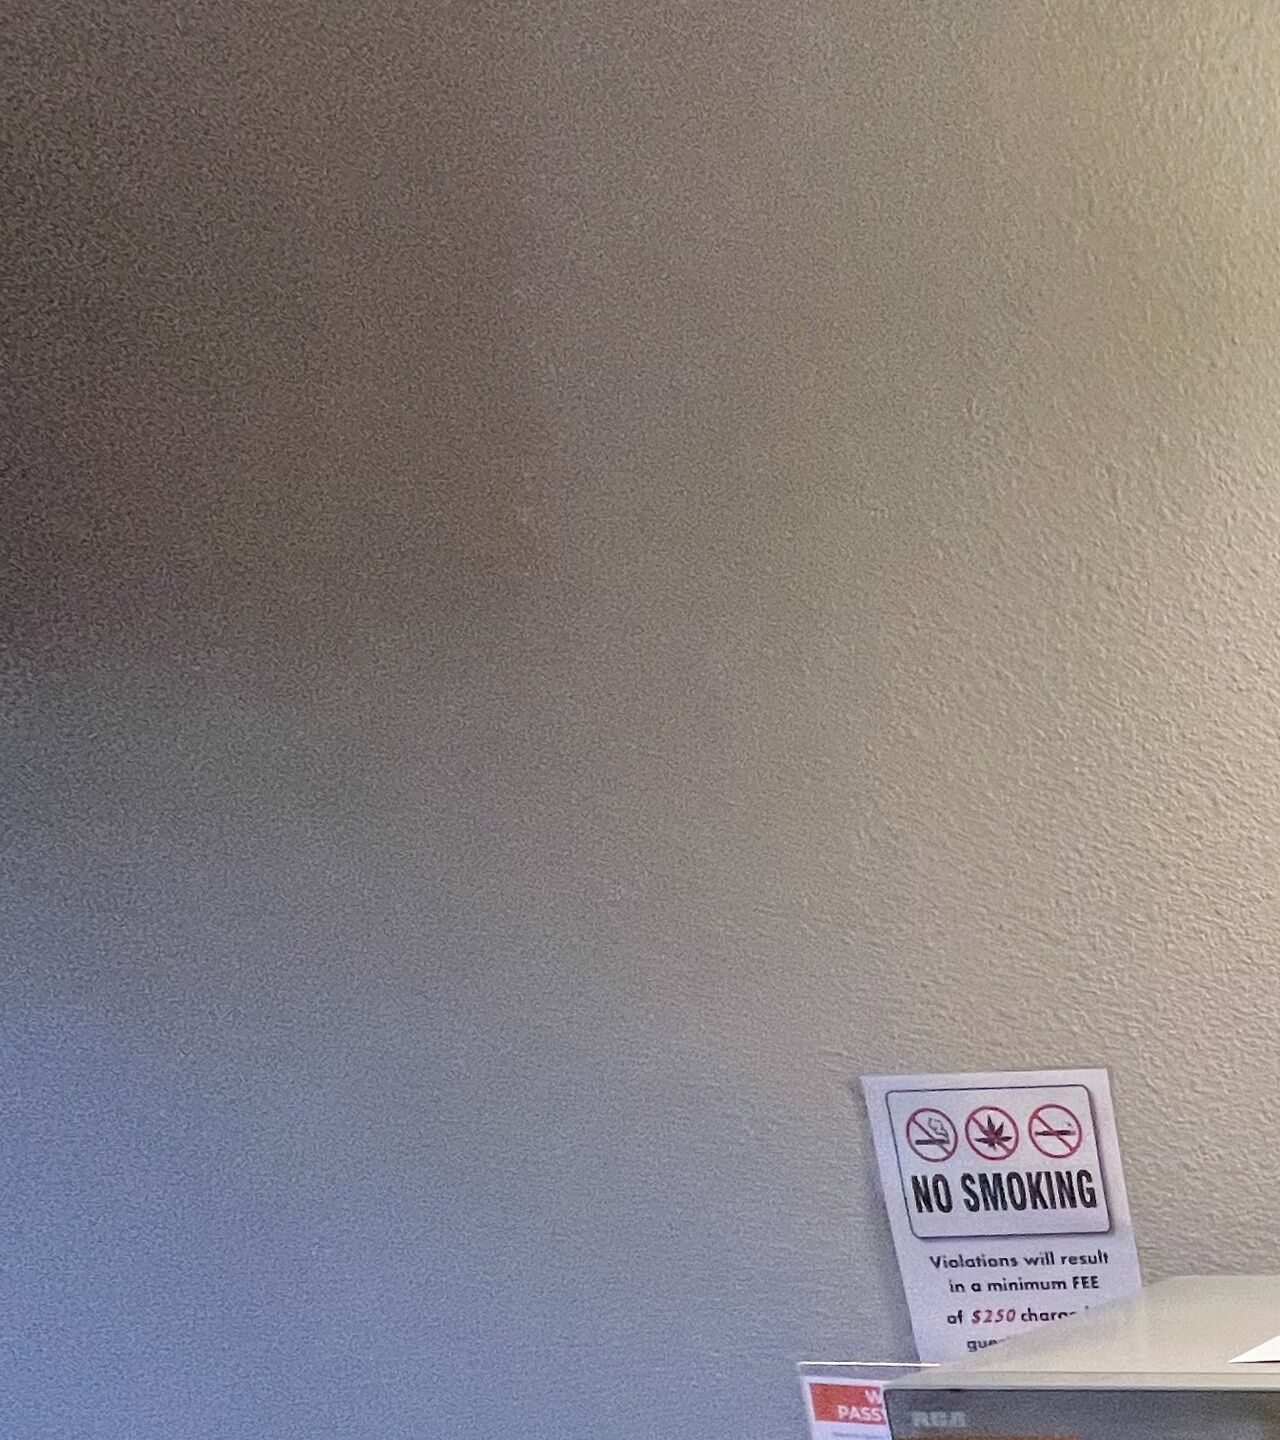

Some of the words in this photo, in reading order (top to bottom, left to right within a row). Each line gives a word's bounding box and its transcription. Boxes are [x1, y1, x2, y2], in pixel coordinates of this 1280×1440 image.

[911, 1174, 953, 1213] NO
[960, 1169, 1098, 1212] SMOKING
[929, 1253, 1019, 1269] Violations
[1024, 1251, 1055, 1266] will
[1060, 1249, 1109, 1265] result
[949, 1279, 965, 1293] in
[971, 1281, 982, 1292] a
[987, 1276, 1067, 1291] minimum
[1072, 1275, 1100, 1290] FEE
[947, 1309, 963, 1325] of
[971, 1308, 1016, 1324] $250
[837, 1405, 887, 1422] PASS
